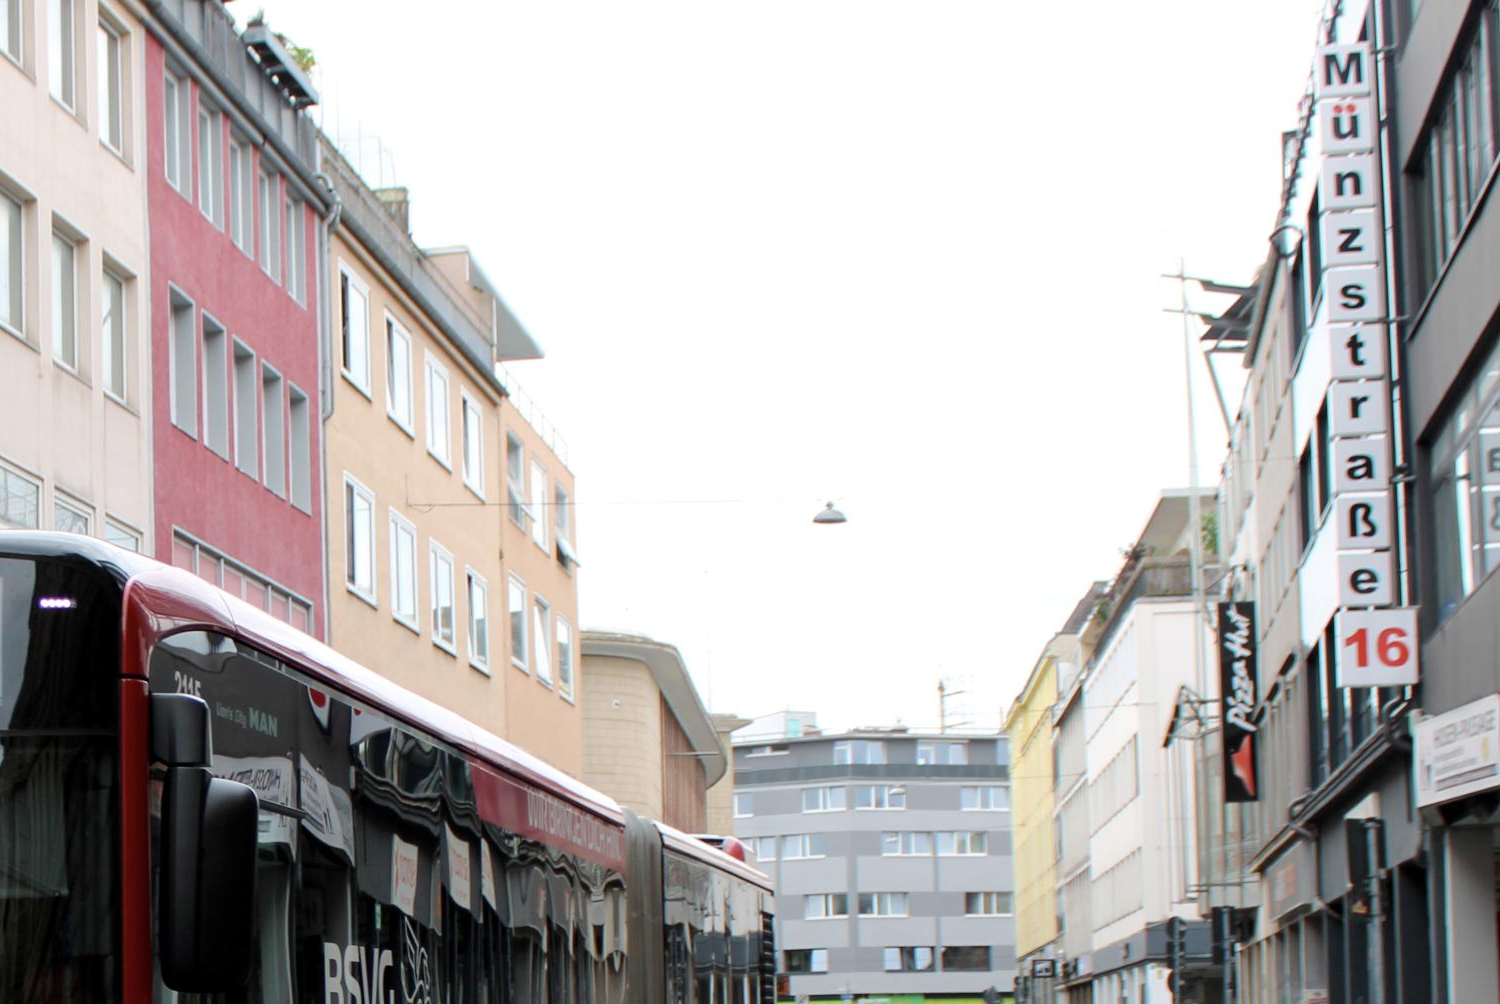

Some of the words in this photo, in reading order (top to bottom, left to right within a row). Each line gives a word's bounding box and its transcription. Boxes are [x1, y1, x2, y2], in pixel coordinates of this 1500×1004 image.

[1323, 52, 1380, 595] Münzstraße
[1344, 627, 1410, 669] 16
[249, 706, 278, 738] MAN
